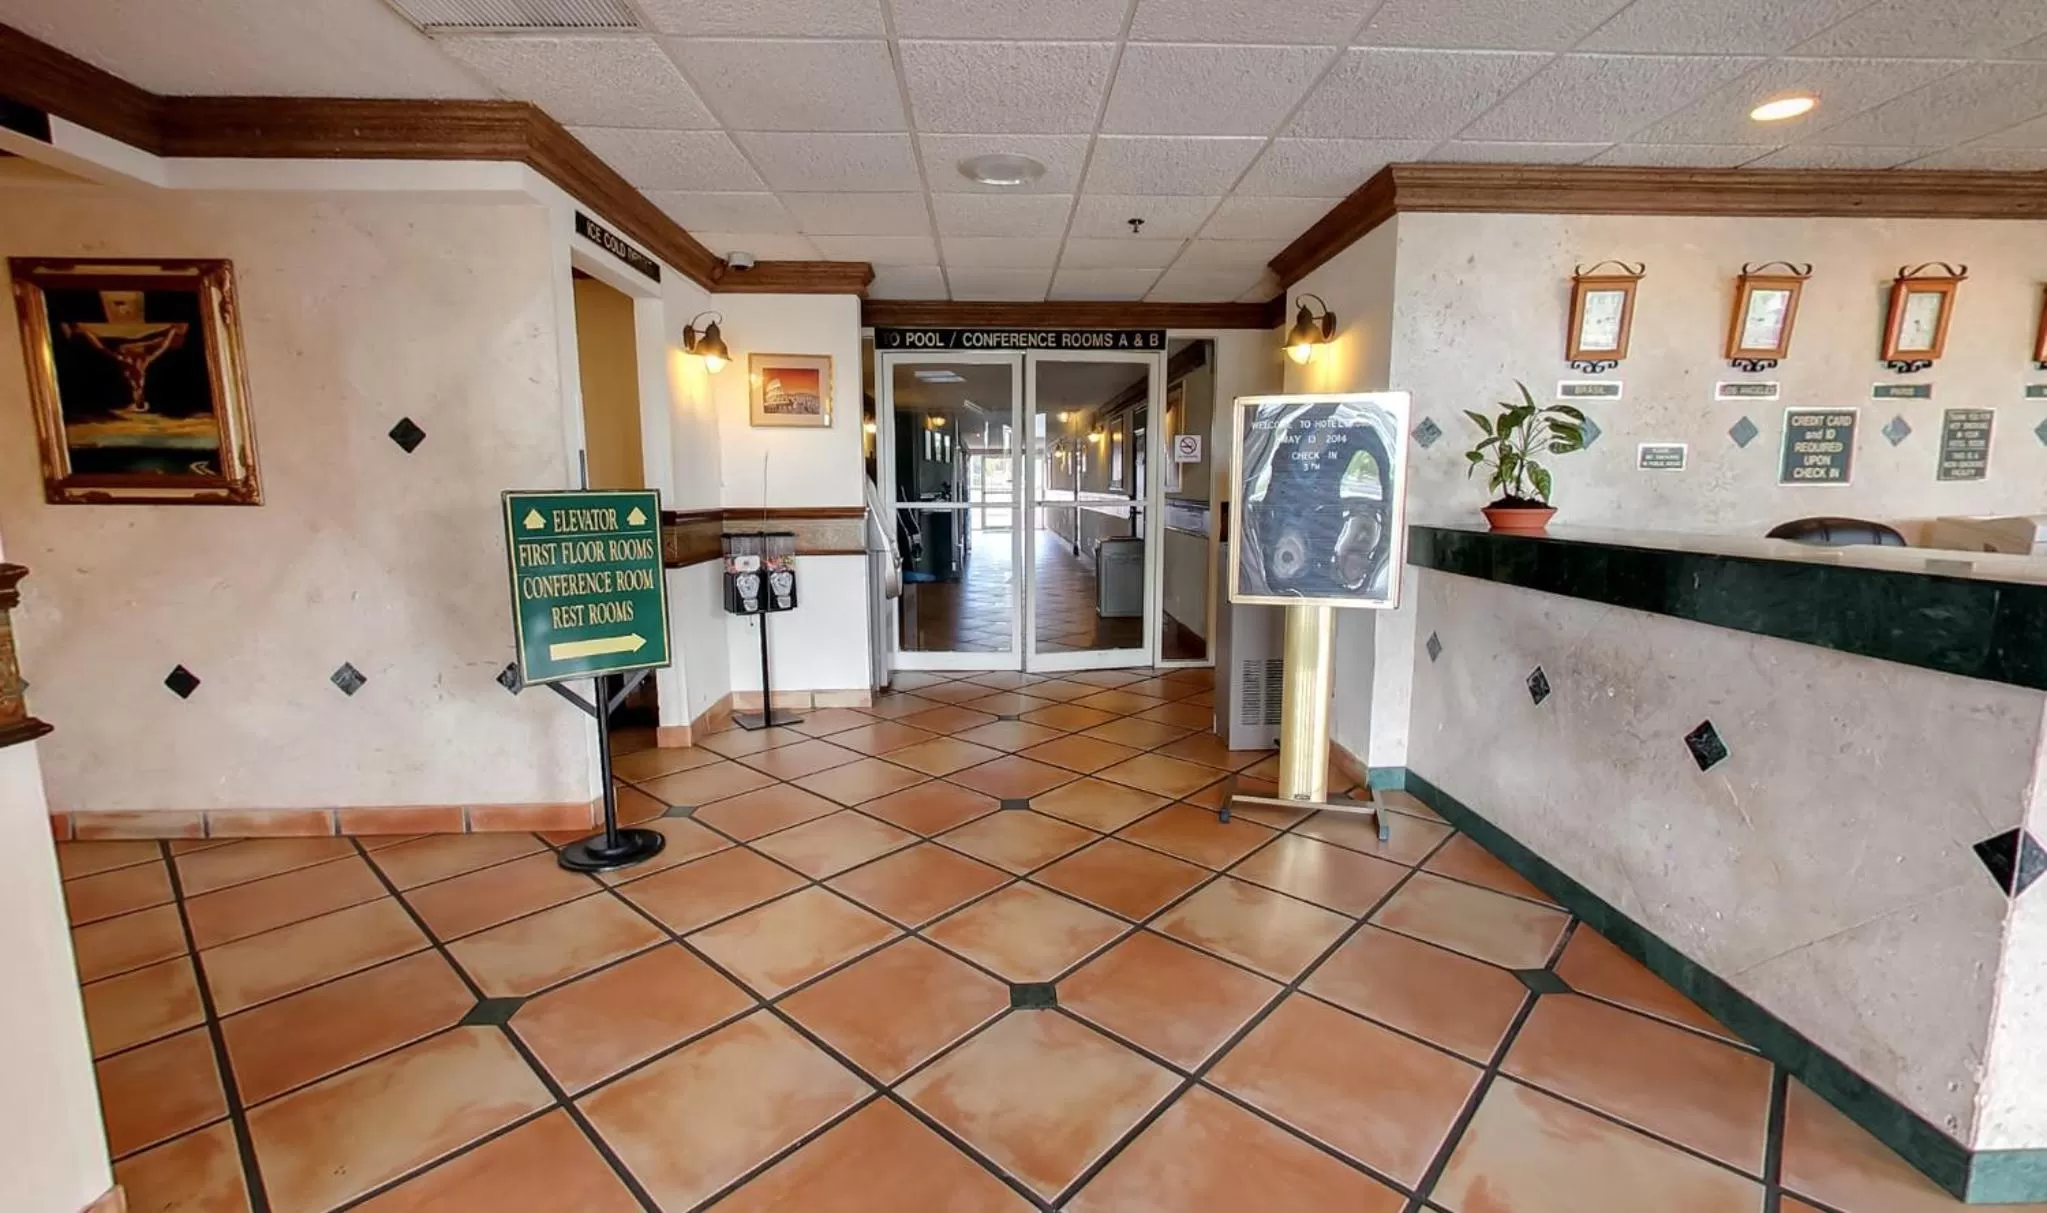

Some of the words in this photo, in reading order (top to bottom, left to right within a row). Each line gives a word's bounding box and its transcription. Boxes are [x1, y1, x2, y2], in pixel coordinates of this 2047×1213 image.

[587, 220, 602, 243] ICE
[604, 232, 626, 258] COLD
[906, 332, 945, 346] POOL
[962, 332, 1057, 347] CONFERENCE
[1062, 333, 1113, 347] ROOMS
[1119, 333, 1128, 347] A
[1134, 333, 1143, 347] &
[1150, 333, 1159, 347] B
[1300, 420, 1311, 428] TO
[1791, 416, 1825, 426] CREDIT
[1826, 416, 1852, 426] CARD
[1326, 434, 1348, 443] 2014
[1805, 429, 1822, 440] and
[1825, 429, 1836, 439] ID
[1794, 442, 1844, 453] REQUIRED
[1291, 451, 1320, 460] CHECK
[1328, 451, 1338, 459] IN
[1804, 455, 1832, 466] UPON
[1793, 467, 1826, 478] CHECK
[1829, 467, 1840, 478] IN
[553, 508, 618, 532] ELEVATOR
[519, 543, 557, 567] FIRST
[562, 541, 606, 564] FLOOR
[609, 539, 654, 561] ROOMS
[523, 571, 613, 599] CONFERENCE
[616, 570, 654, 591] ROOM
[552, 605, 585, 629] REST
[589, 600, 634, 624] ROOMS
